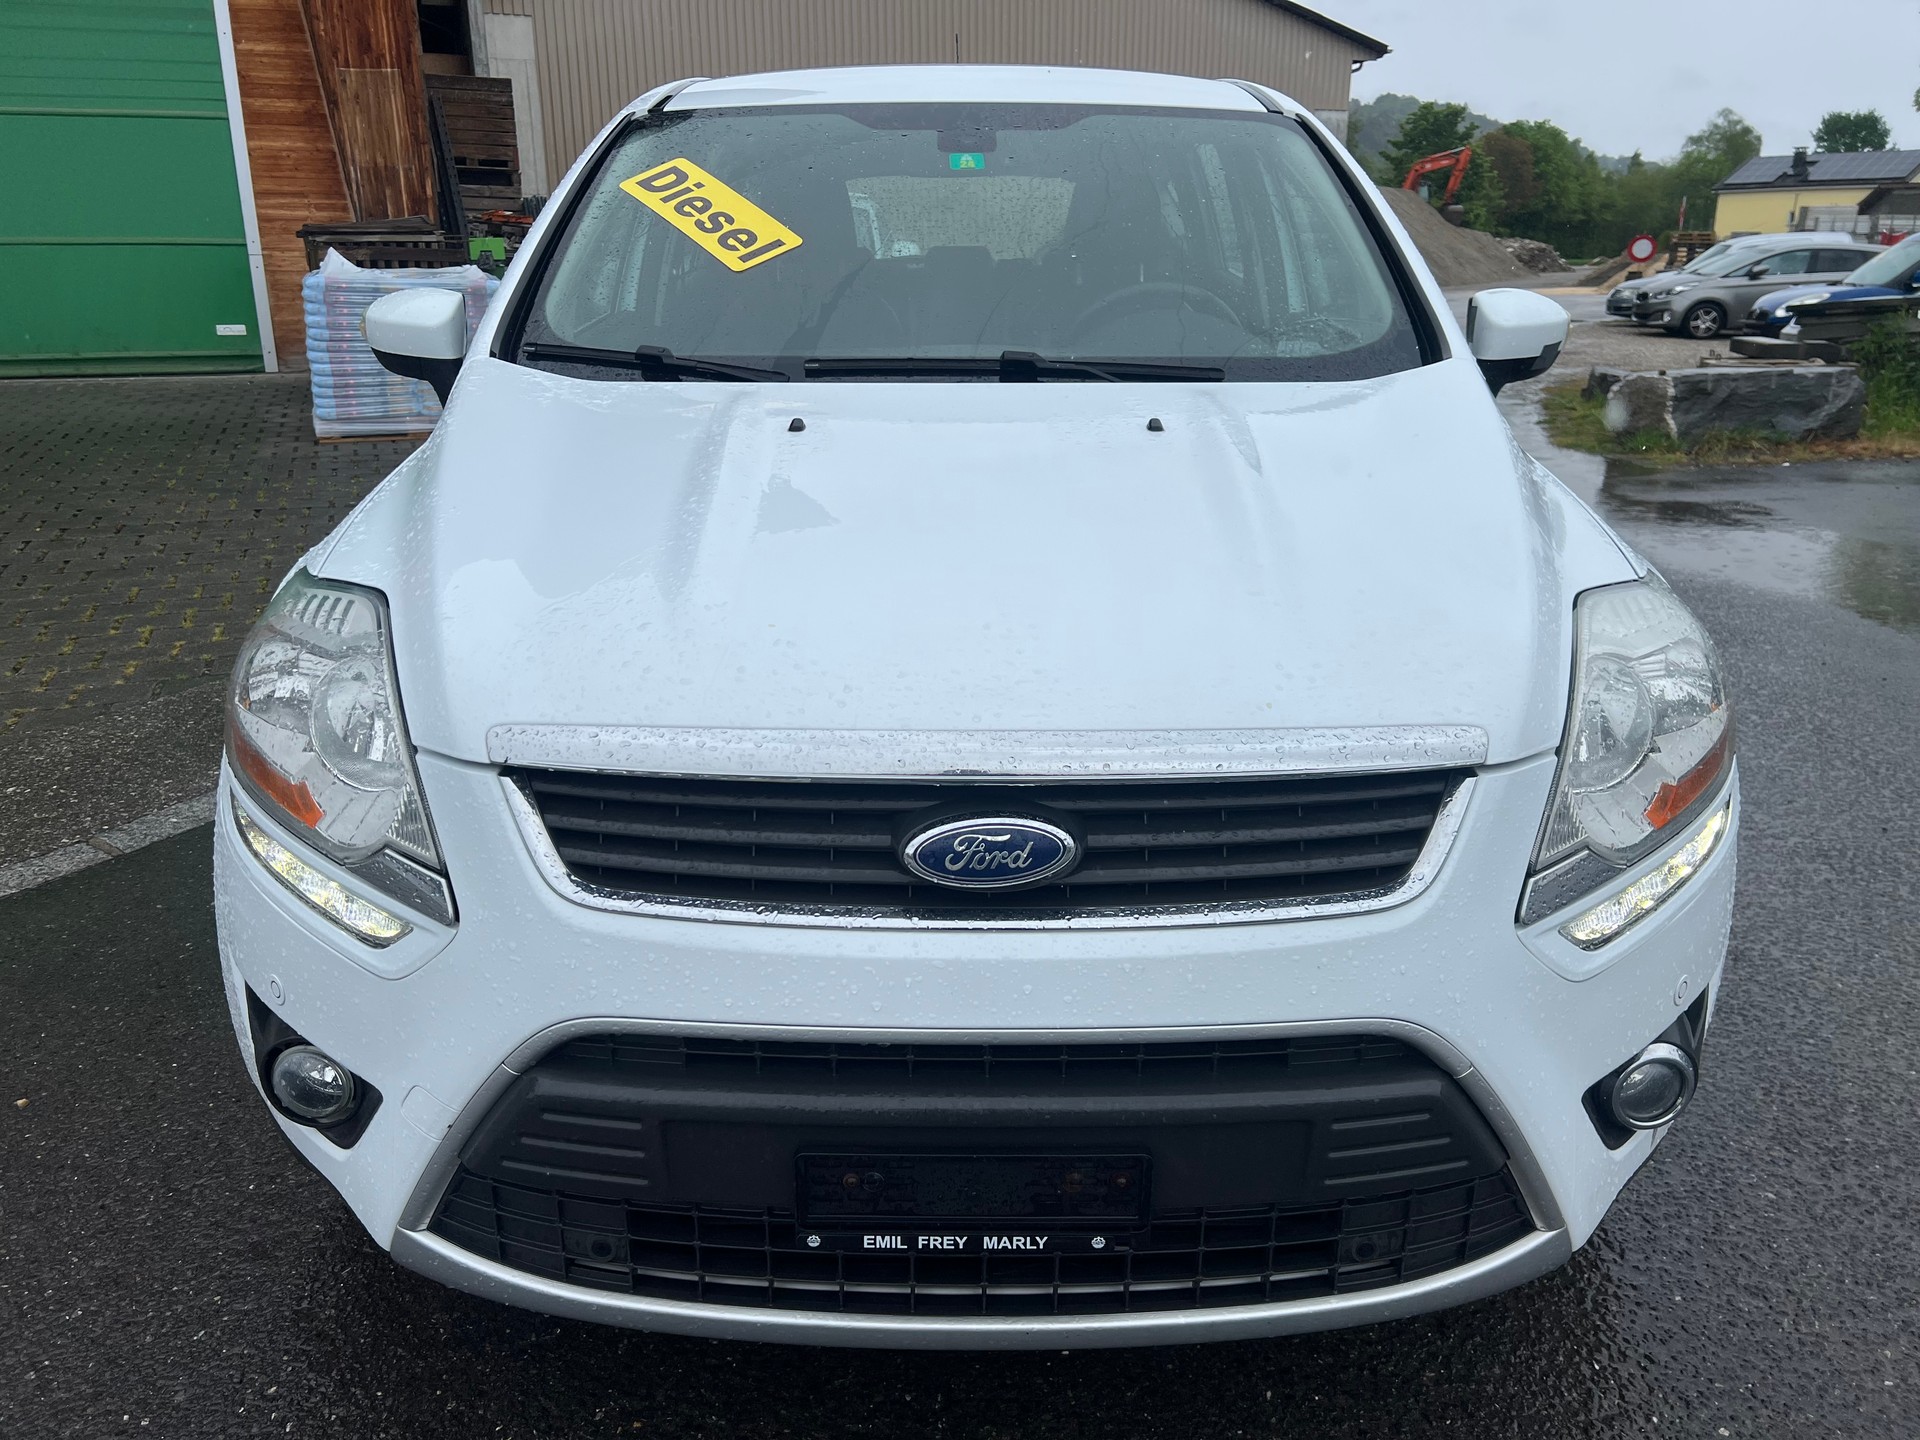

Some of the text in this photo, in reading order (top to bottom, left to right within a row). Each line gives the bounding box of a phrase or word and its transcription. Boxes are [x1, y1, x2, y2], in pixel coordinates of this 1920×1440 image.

[635, 165, 787, 263] Diesel
[944, 834, 1034, 871] Ford
[863, 1235, 1049, 1250] EMIL FREY MARLY
